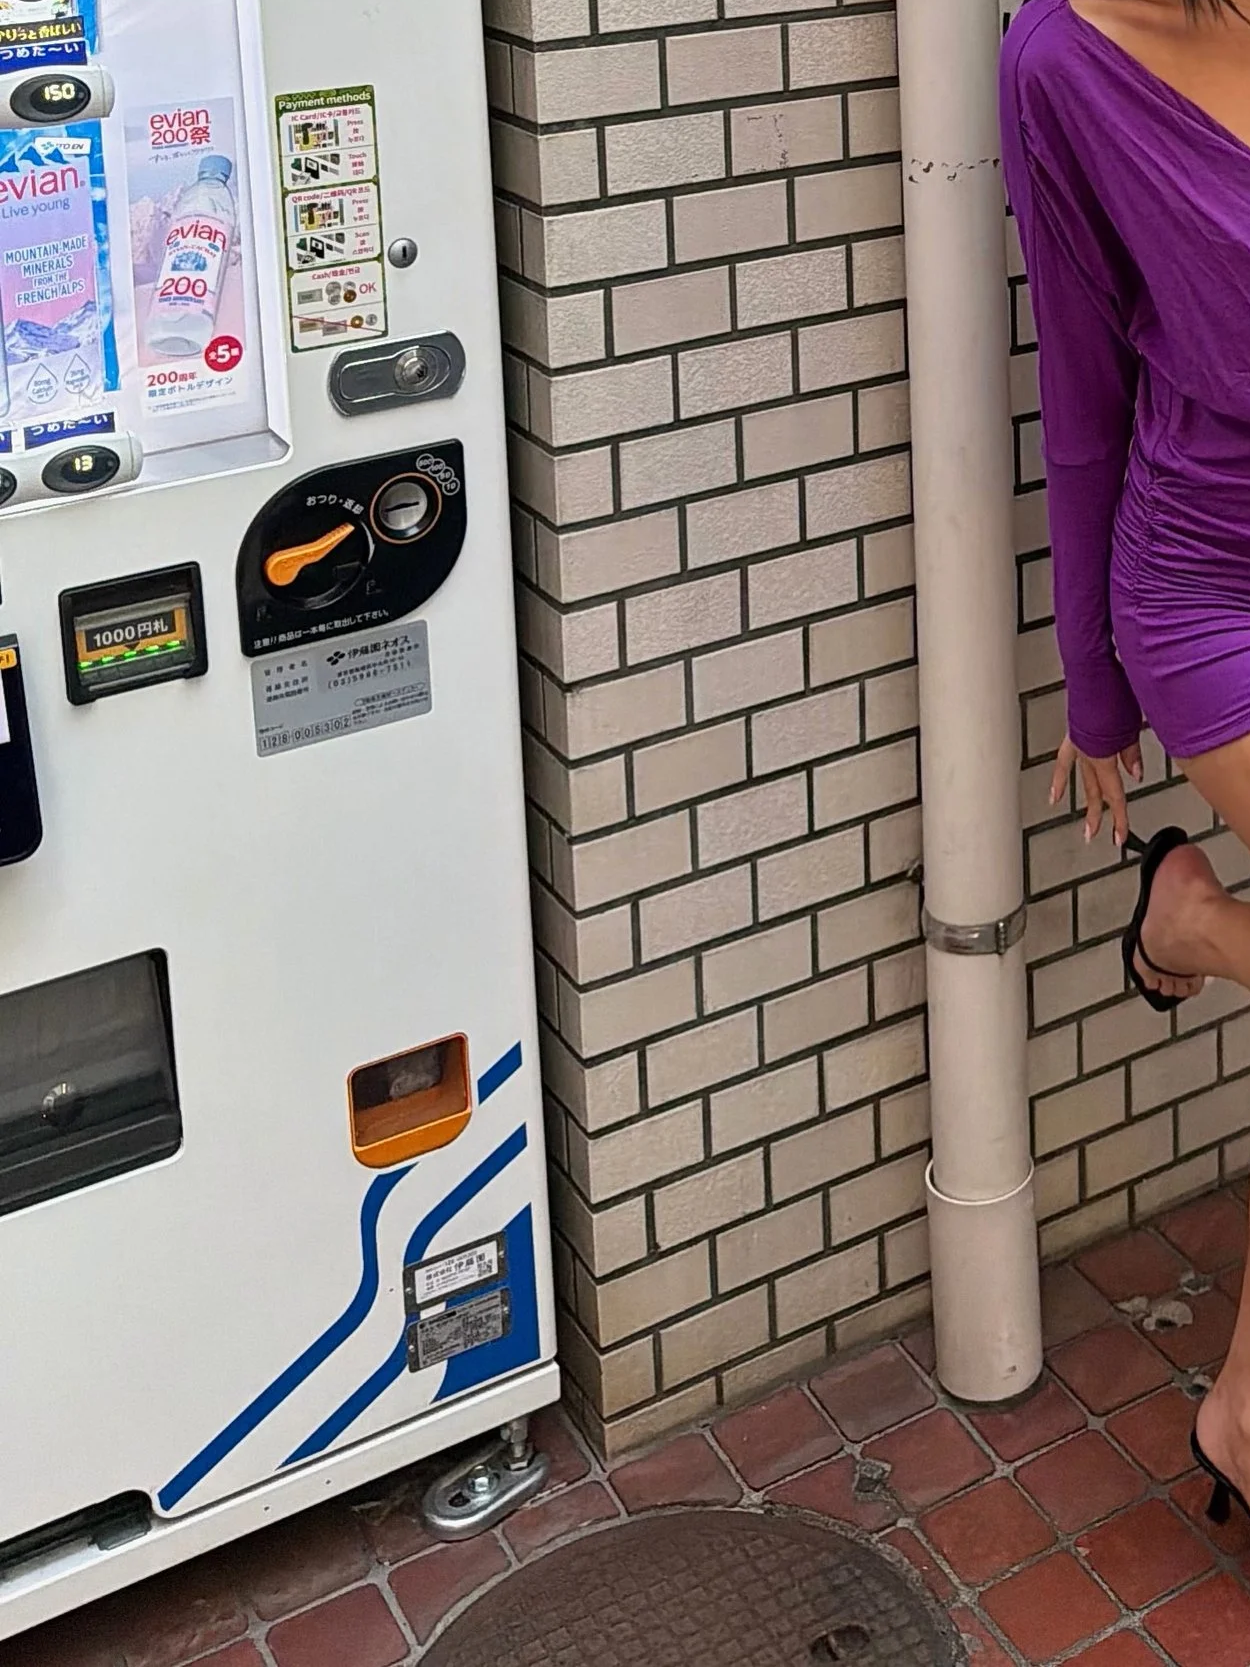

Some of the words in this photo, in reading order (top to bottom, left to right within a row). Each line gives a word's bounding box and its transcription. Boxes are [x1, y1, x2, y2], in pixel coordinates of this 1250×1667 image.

[278, 97, 325, 111] Payment
[326, 90, 372, 105] methods
[2, 203, 29, 219] Live
[33, 197, 71, 216] young
[5, 236, 87, 264] MOUNTAIN-MADE
[23, 255, 73, 277] MINERALS
[34, 275, 54, 287] FROM
[55, 271, 67, 282] THE
[160, 275, 208, 298] 200
[358, 282, 378, 295] OK
[17, 287, 58, 306] FRENCH
[61, 279, 85, 296] ALPS
[93, 618, 169, 648] 1000円札
